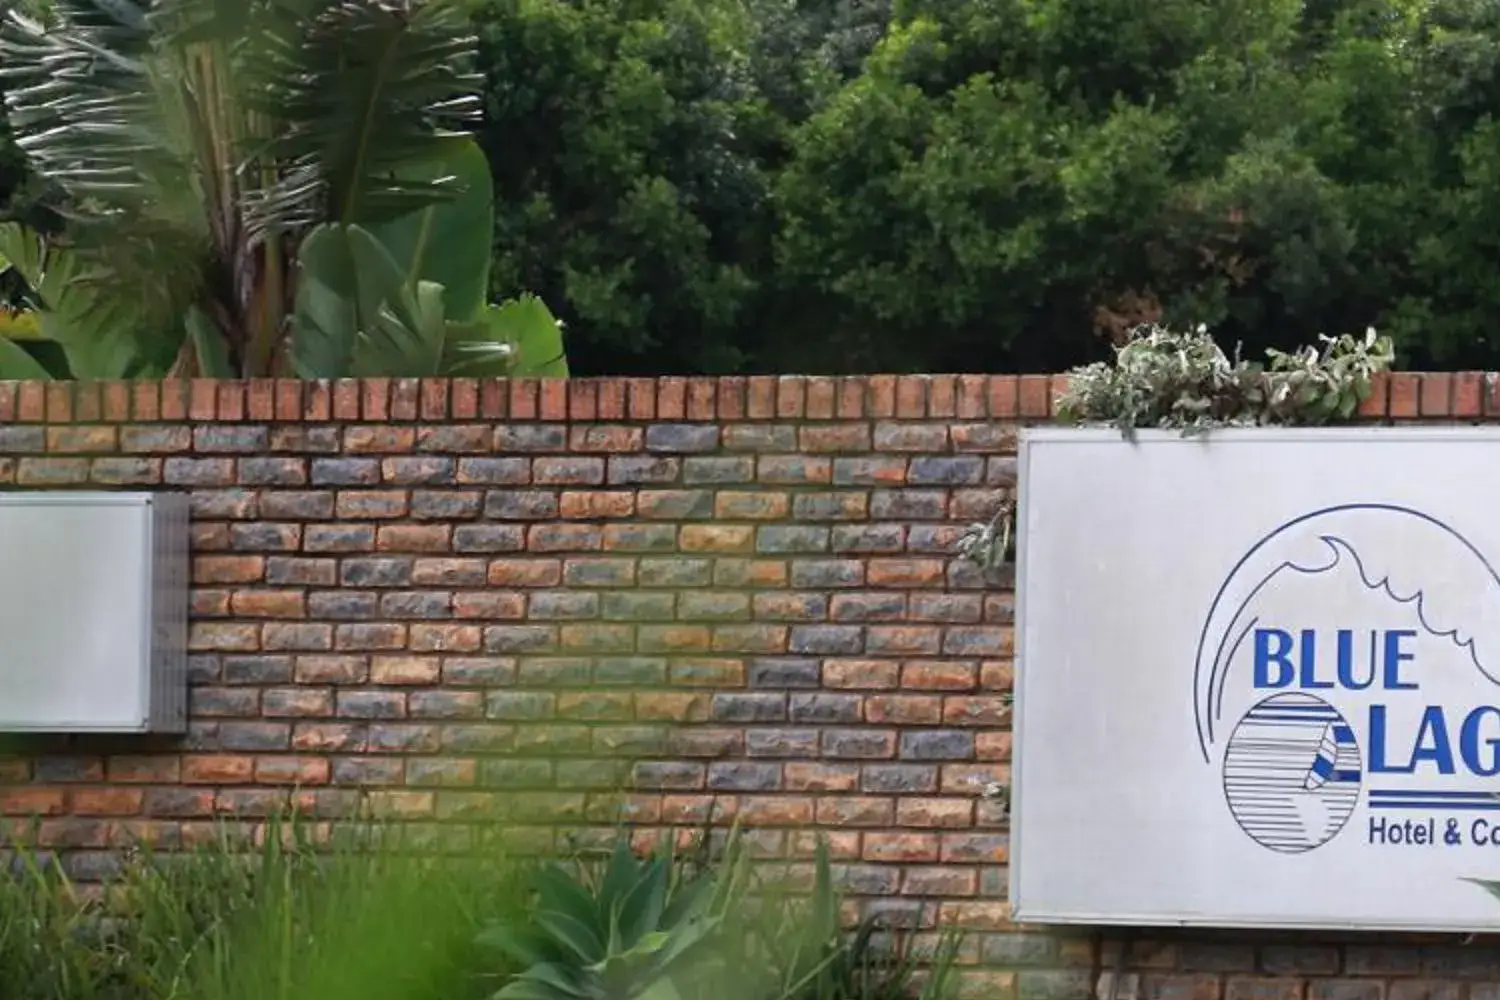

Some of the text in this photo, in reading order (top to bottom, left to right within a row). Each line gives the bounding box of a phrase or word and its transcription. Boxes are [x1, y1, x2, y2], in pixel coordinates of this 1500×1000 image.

[1254, 628, 1419, 690] BLUE
[1368, 816, 1434, 845] Hotel
[1443, 817, 1462, 846] &
